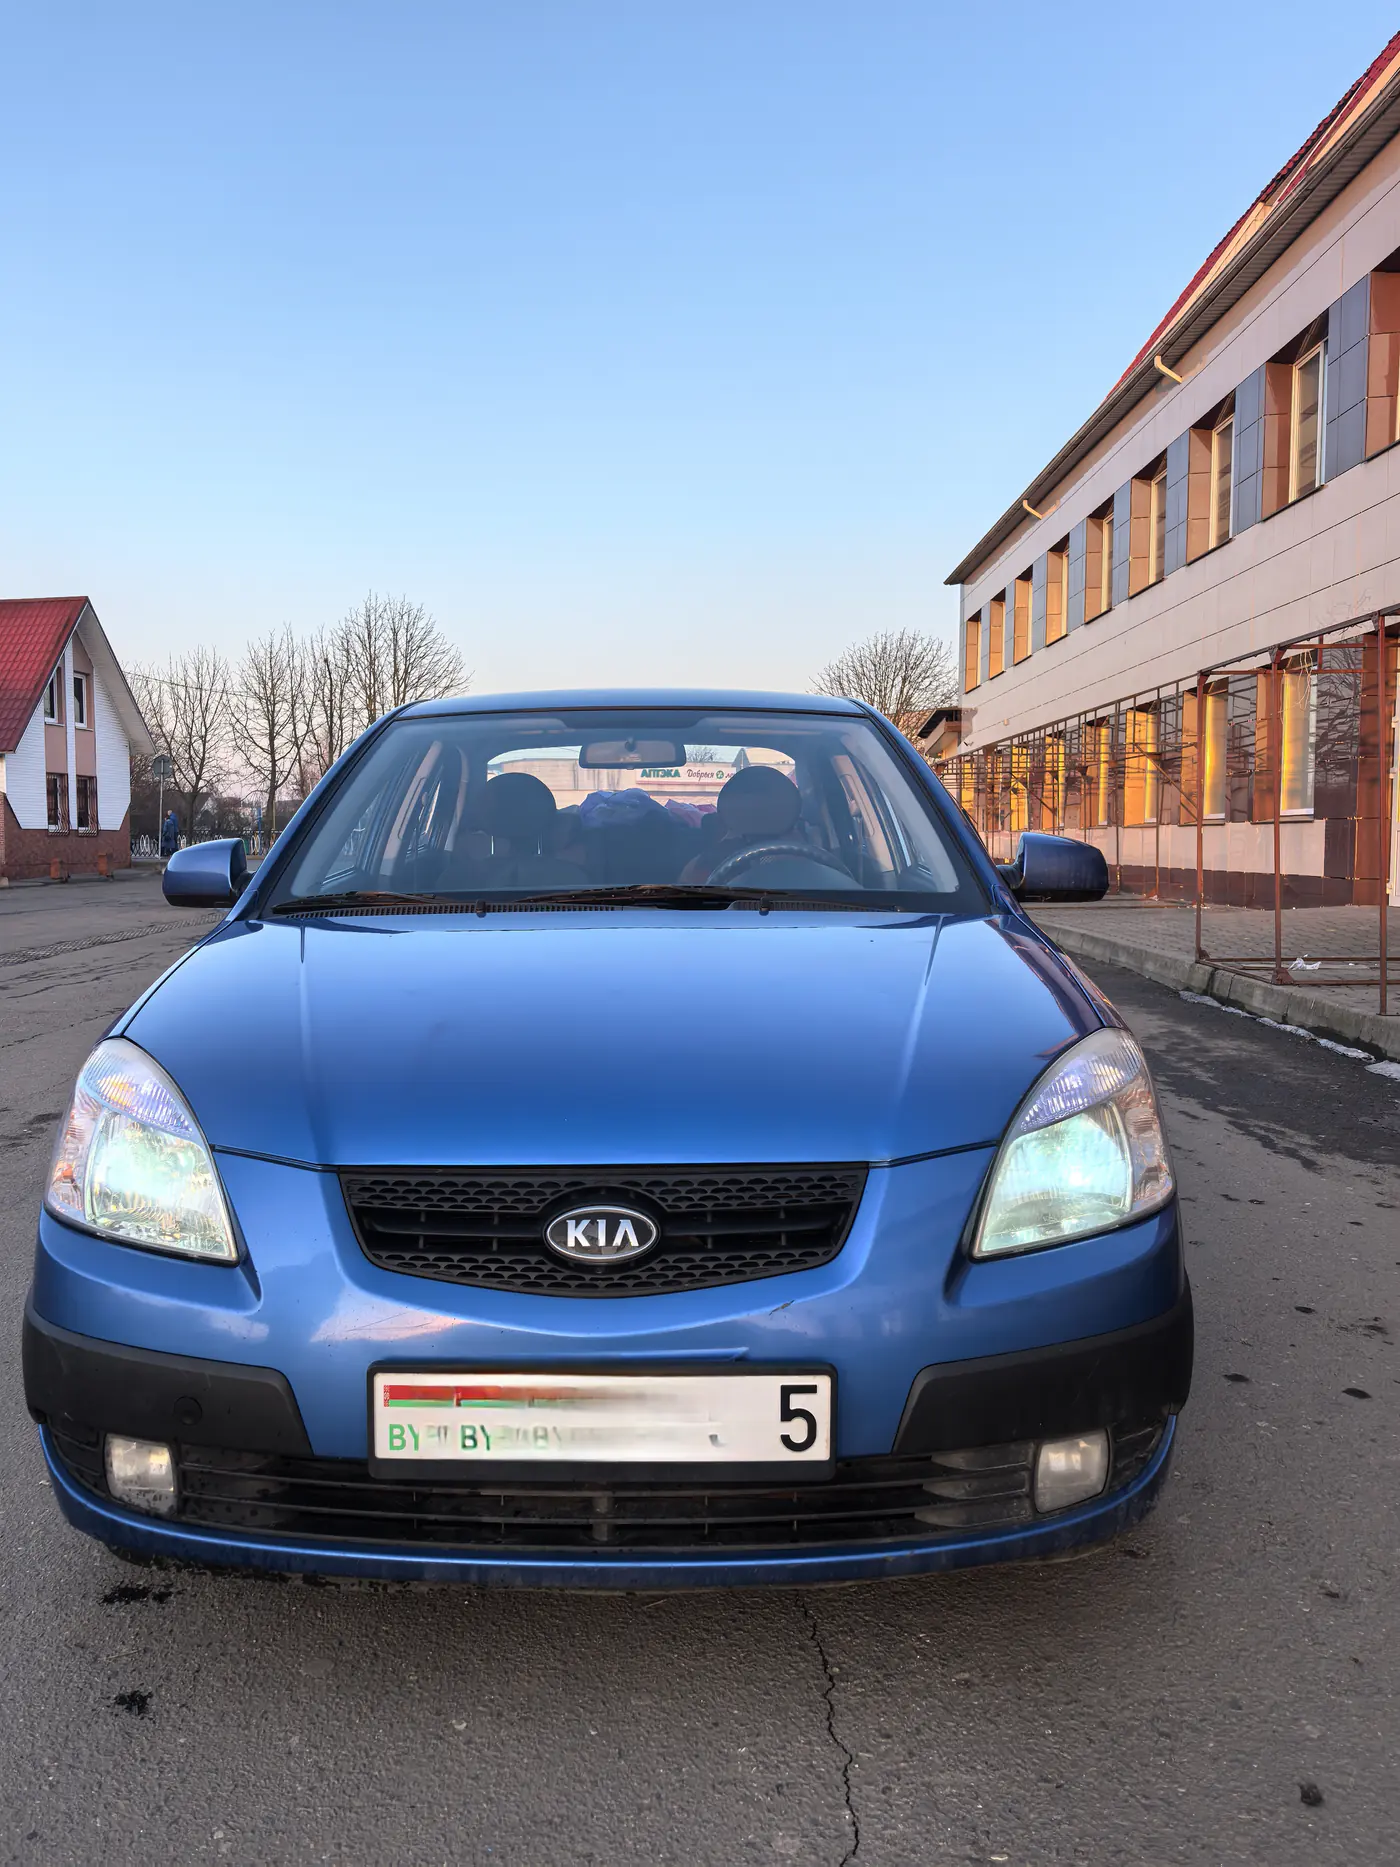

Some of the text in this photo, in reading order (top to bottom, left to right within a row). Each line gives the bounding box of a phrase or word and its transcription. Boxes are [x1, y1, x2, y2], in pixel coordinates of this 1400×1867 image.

[640, 768, 681, 778] АПТЭКА
[566, 1219, 640, 1247] KIA
[780, 1384, 818, 1452] 5
